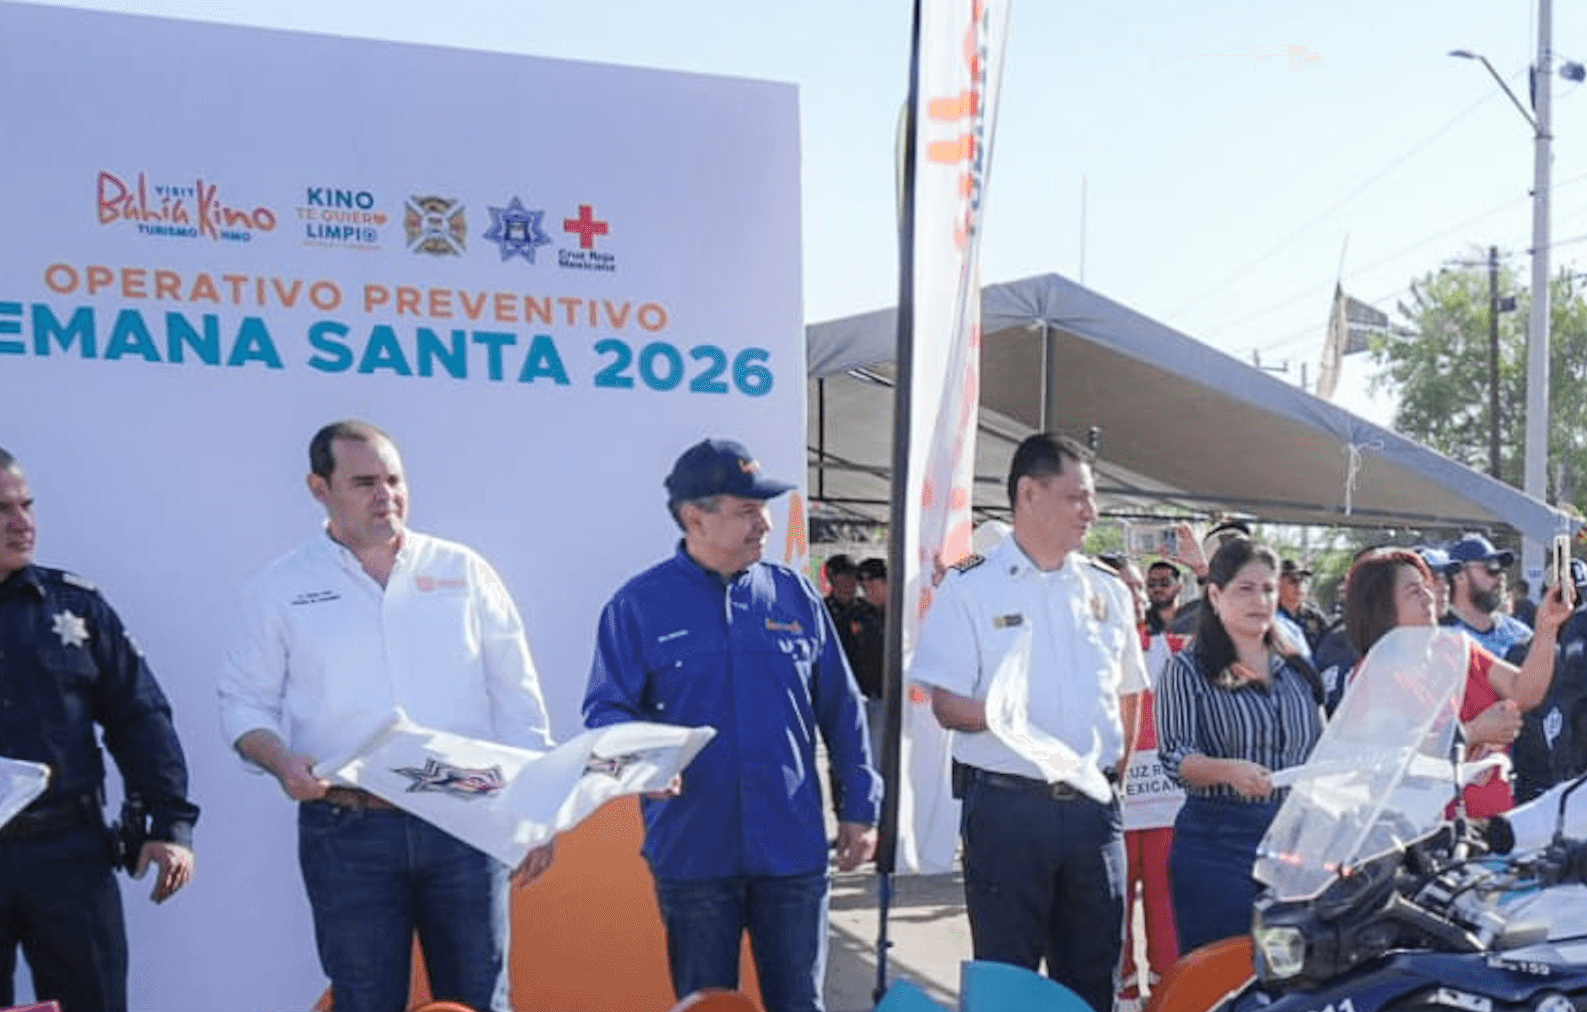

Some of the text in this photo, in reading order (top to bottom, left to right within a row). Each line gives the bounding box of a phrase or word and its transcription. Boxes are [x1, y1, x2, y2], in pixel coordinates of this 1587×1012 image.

[197, 179, 277, 240] Kino
[307, 187, 374, 210] KINO
[138, 223, 198, 238] TURISMO
[44, 262, 669, 333] OPERATIVO PREVENTIVO
[307, 320, 571, 388] SANTA
[593, 338, 775, 398] 2026
